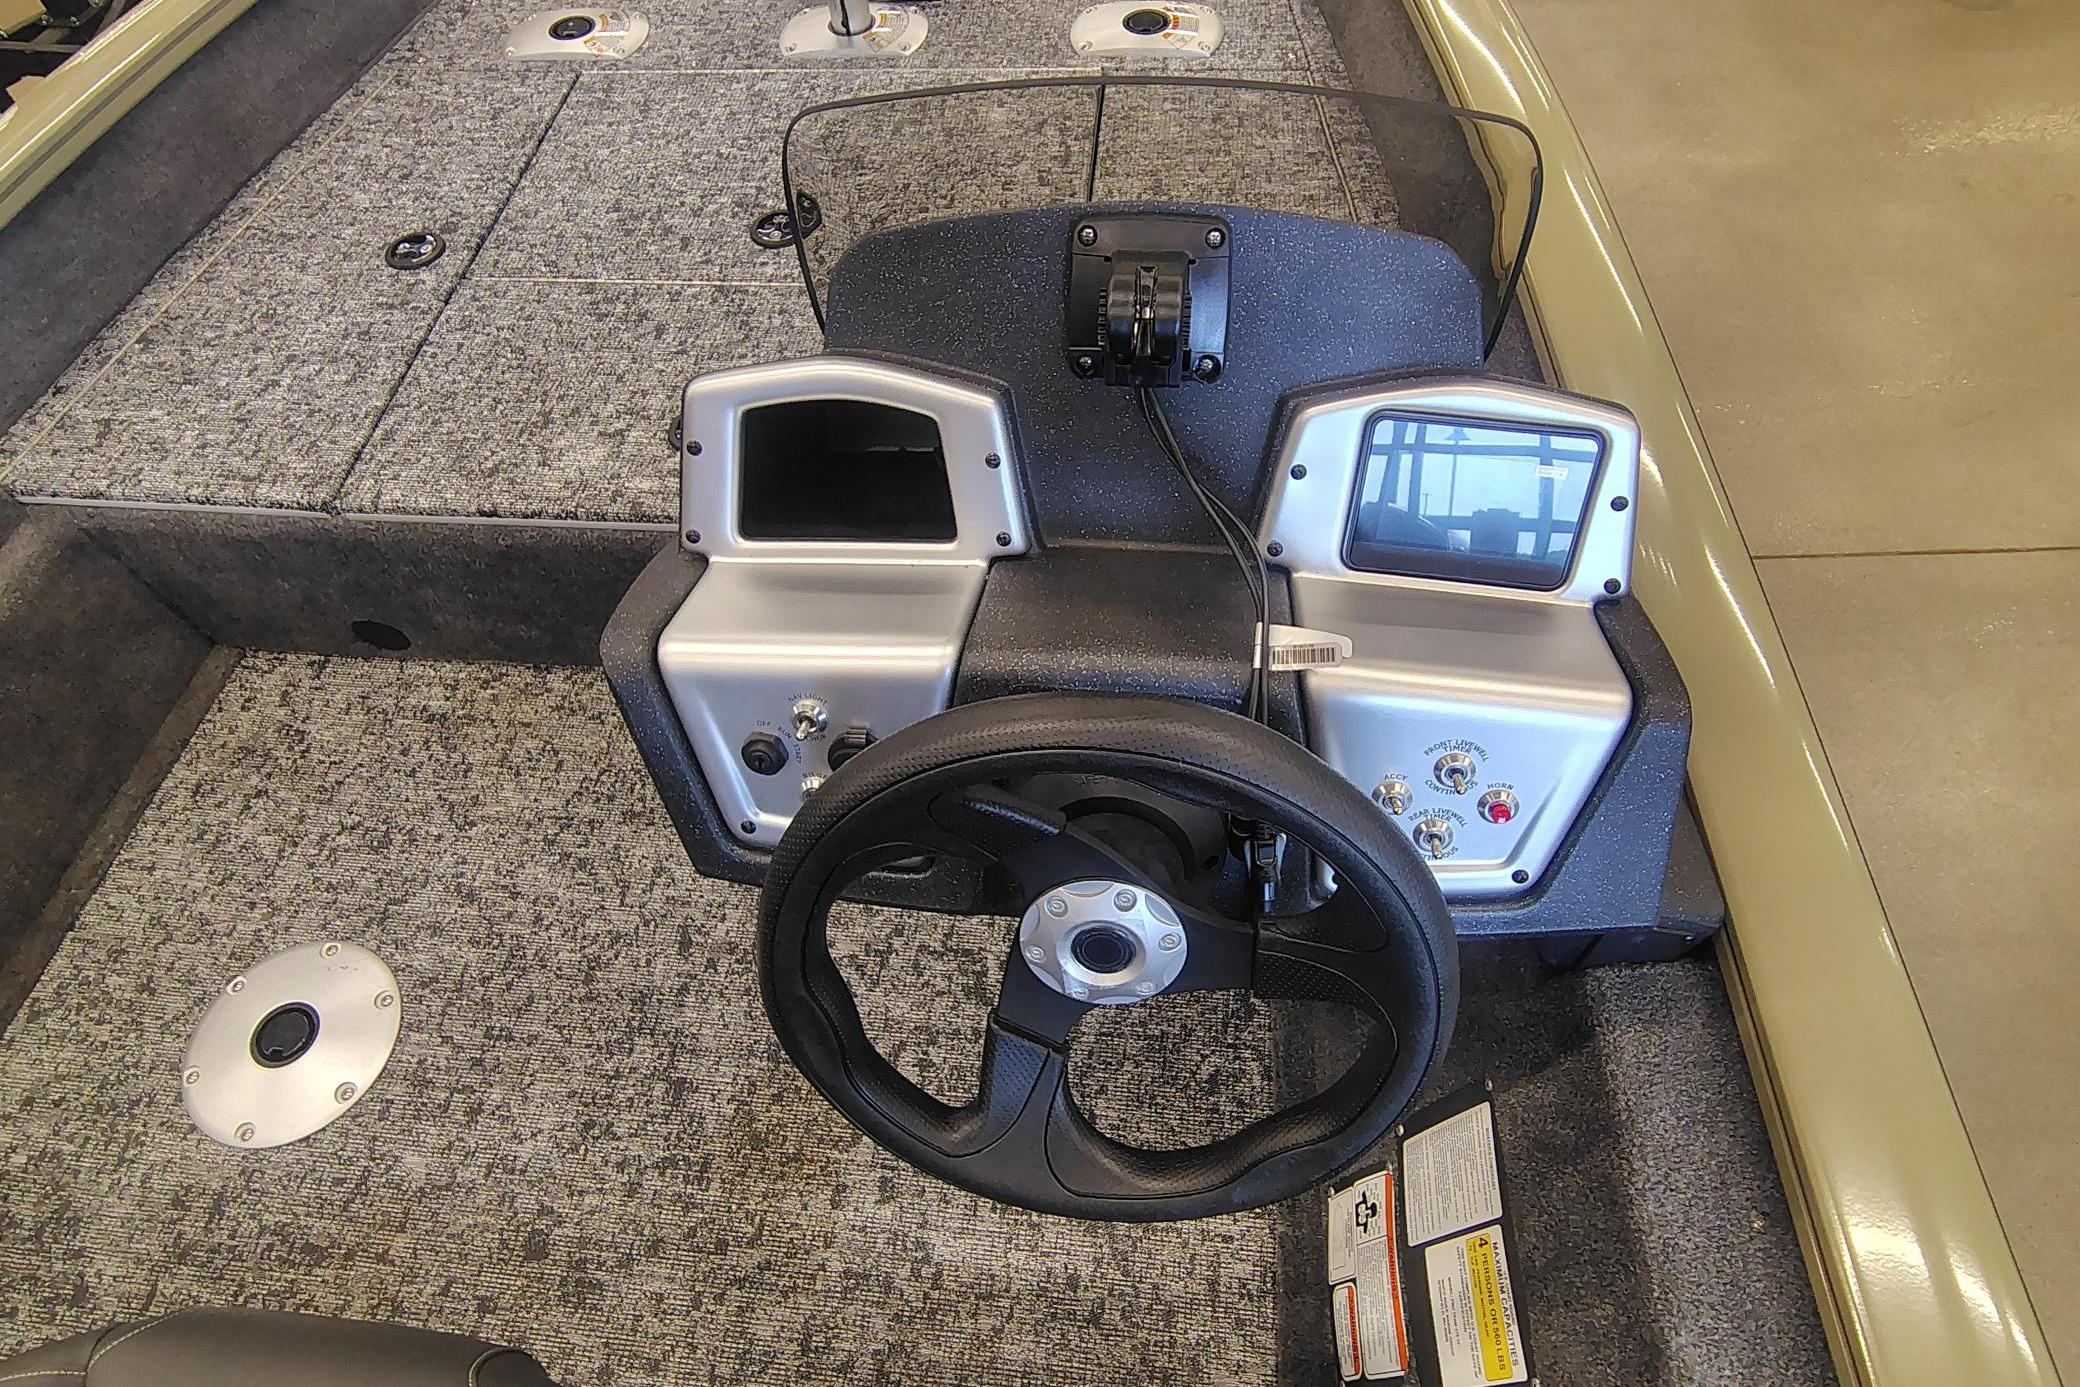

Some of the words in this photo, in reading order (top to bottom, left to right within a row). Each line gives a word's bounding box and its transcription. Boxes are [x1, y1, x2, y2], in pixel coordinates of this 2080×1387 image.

[1424, 739, 1453, 756] FRONT
[1455, 739, 1489, 762] LIVEWELL
[1444, 745, 1472, 754] TIMER
[1384, 773, 1409, 781] ACCY
[1425, 779, 1479, 795] CONTINUS
[1488, 781, 1515, 791] HORN
[1408, 808, 1430, 822] REAR
[1432, 808, 1468, 828] LIVEWELL
[1424, 814, 1452, 822] TIMER
[1477, 1236, 1488, 1248] 4
[1481, 1252, 1494, 1305] PERSONS
[1492, 1241, 1506, 1294] MAXIMUM
[1501, 1296, 1518, 1366] CAPACITIES
[1489, 1308, 1498, 1325] OR
[1493, 1327, 1501, 1345] 560
[1496, 1347, 1505, 1370] LBS
